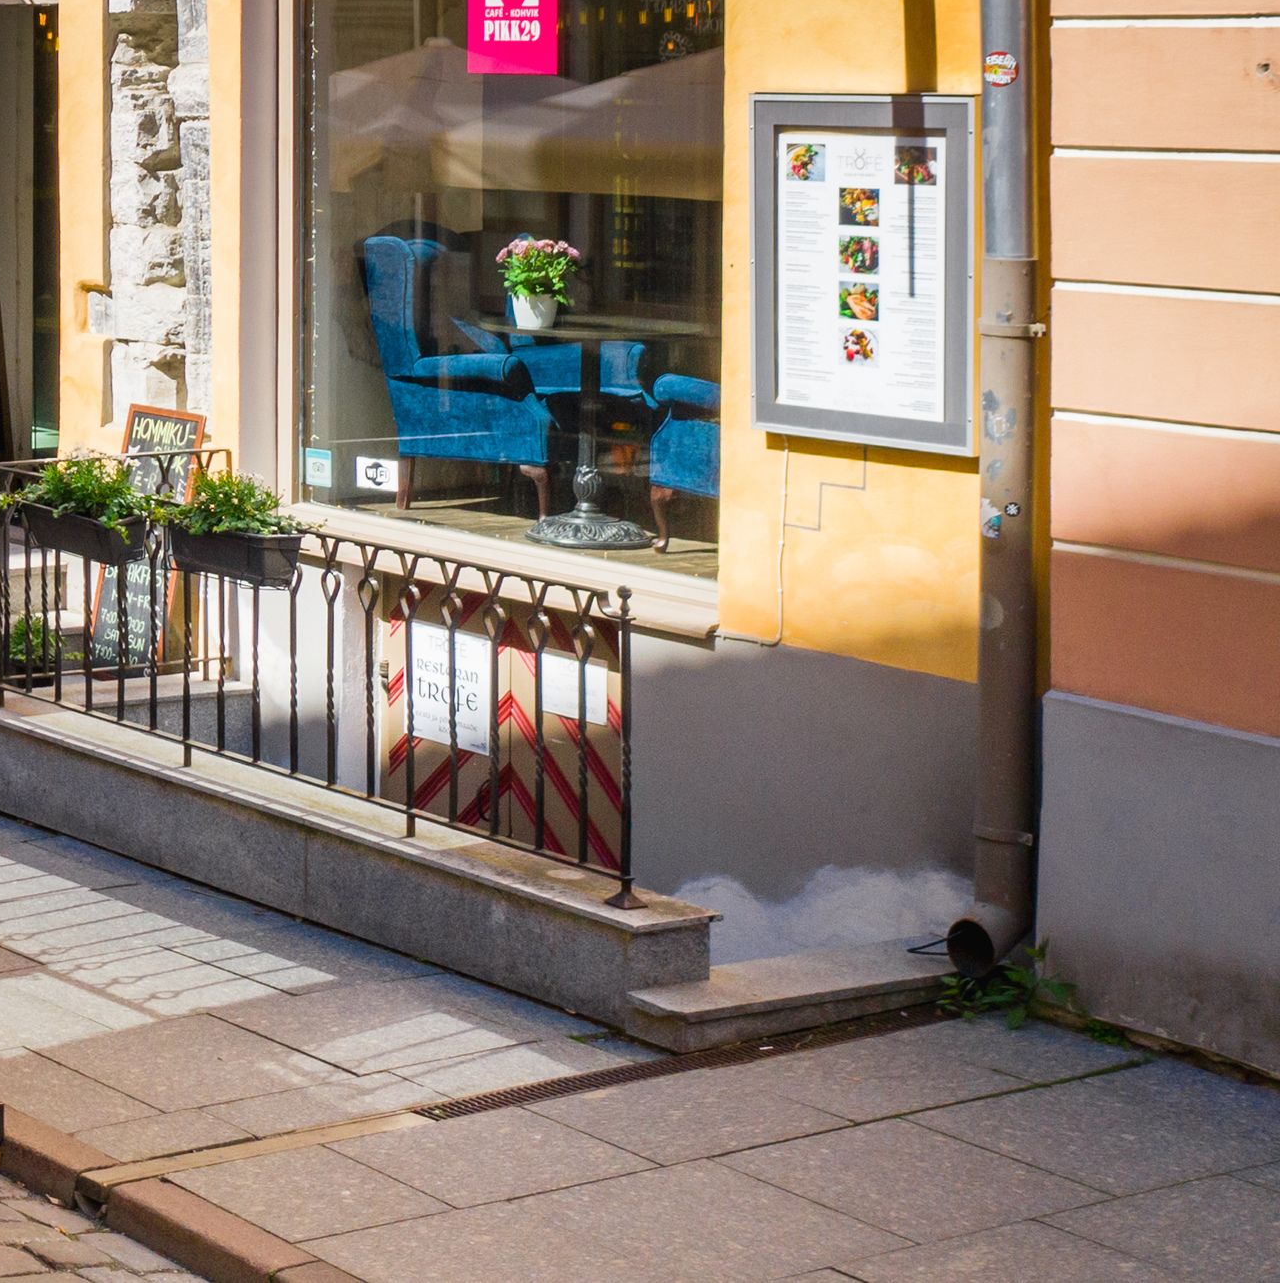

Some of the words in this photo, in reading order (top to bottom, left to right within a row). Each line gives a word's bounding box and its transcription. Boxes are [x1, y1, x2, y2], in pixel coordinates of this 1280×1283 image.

[485, 7, 503, 17] CAFÉ
[510, 8, 539, 17] KOHVIK
[483, 20, 541, 42] PIKK29
